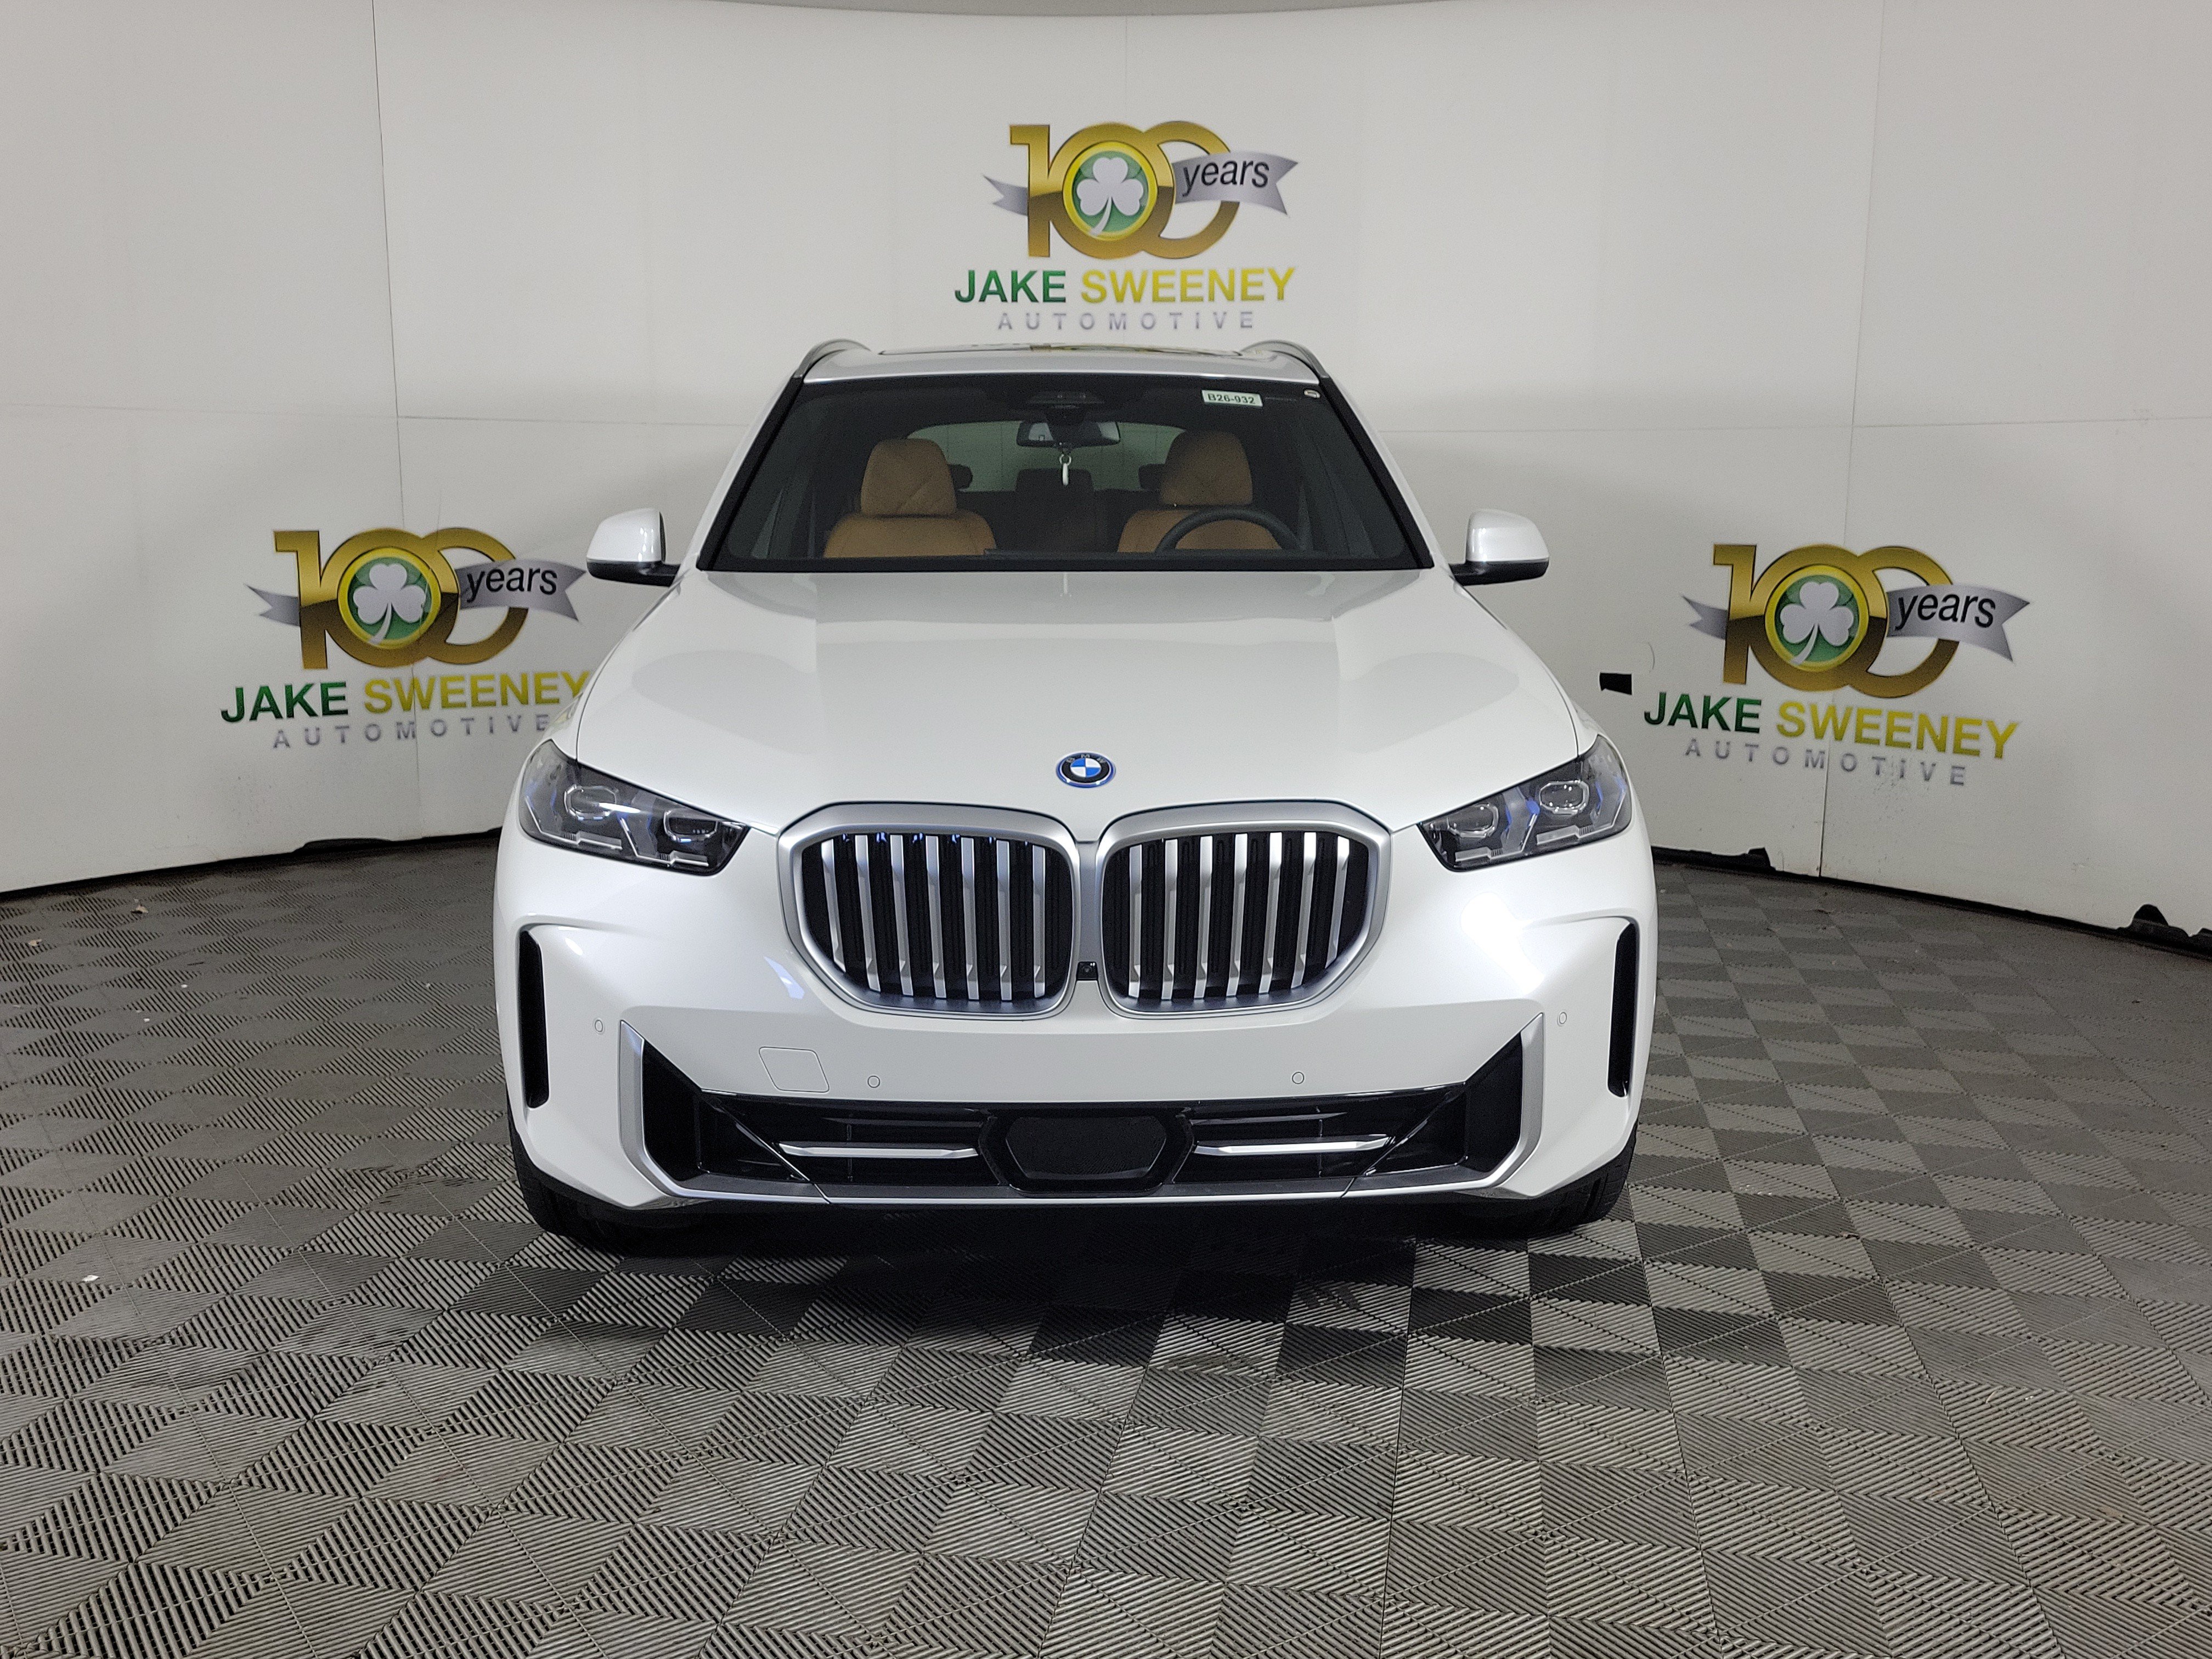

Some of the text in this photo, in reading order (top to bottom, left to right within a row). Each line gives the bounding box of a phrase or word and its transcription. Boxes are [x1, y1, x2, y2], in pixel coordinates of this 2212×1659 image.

[1009, 121, 1269, 259] 100 years
[955, 267, 1295, 303] JAKE SWEENEY
[997, 311, 1253, 330] AUTOMOTIVE
[273, 528, 558, 669] 100 years
[1712, 544, 1996, 698] 100 years
[221, 671, 590, 723] JAKE SWEENEY
[273, 714, 550, 749] AUTOMOTIVE
[1643, 692, 2019, 759] JAKE SWEENEY
[1065, 753, 1106, 763] BMW
[1685, 738, 1966, 786] AUTOMOTIVE
